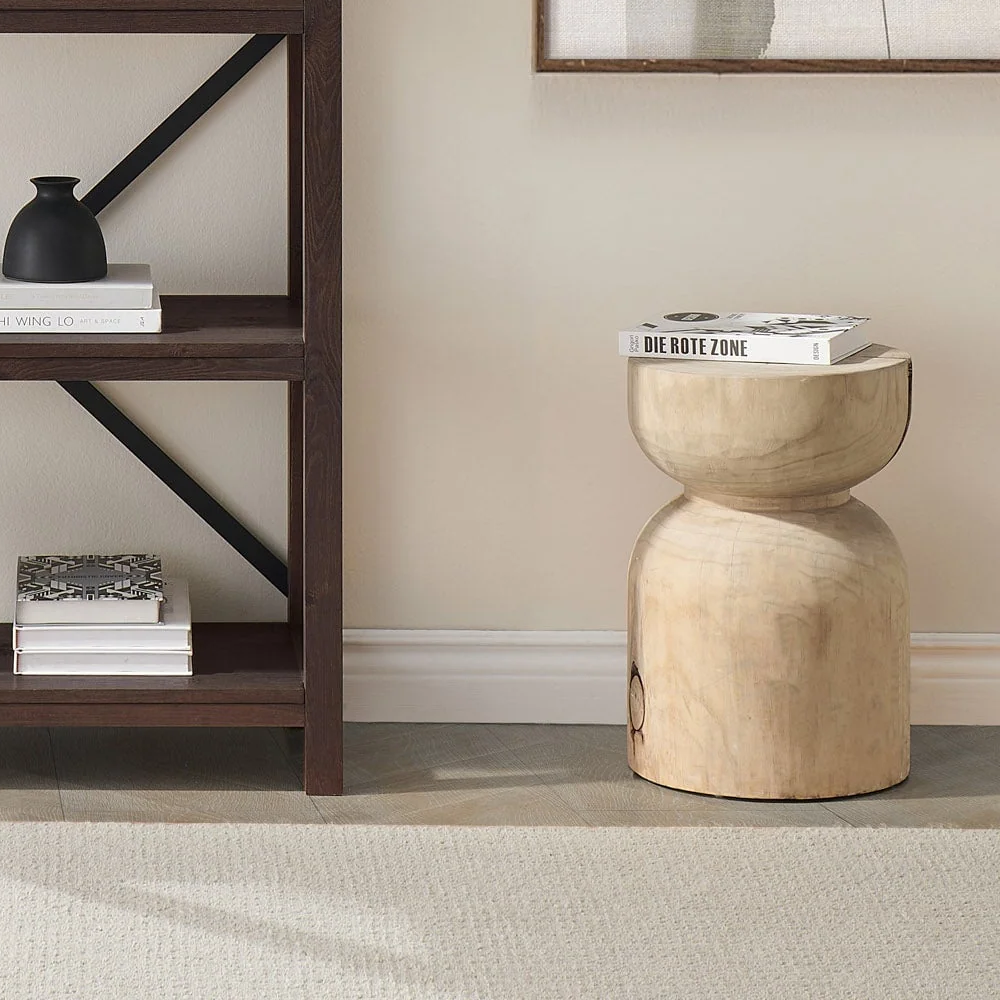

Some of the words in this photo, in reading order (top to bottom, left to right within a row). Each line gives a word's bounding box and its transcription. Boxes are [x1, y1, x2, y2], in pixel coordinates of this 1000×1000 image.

[15, 316, 52, 327] WING
[57, 316, 74, 327] LO
[644, 336, 667, 354] DIE
[670, 337, 707, 356] ROTE
[710, 338, 748, 357] ZONE
[812, 342, 820, 361] DESIGN
